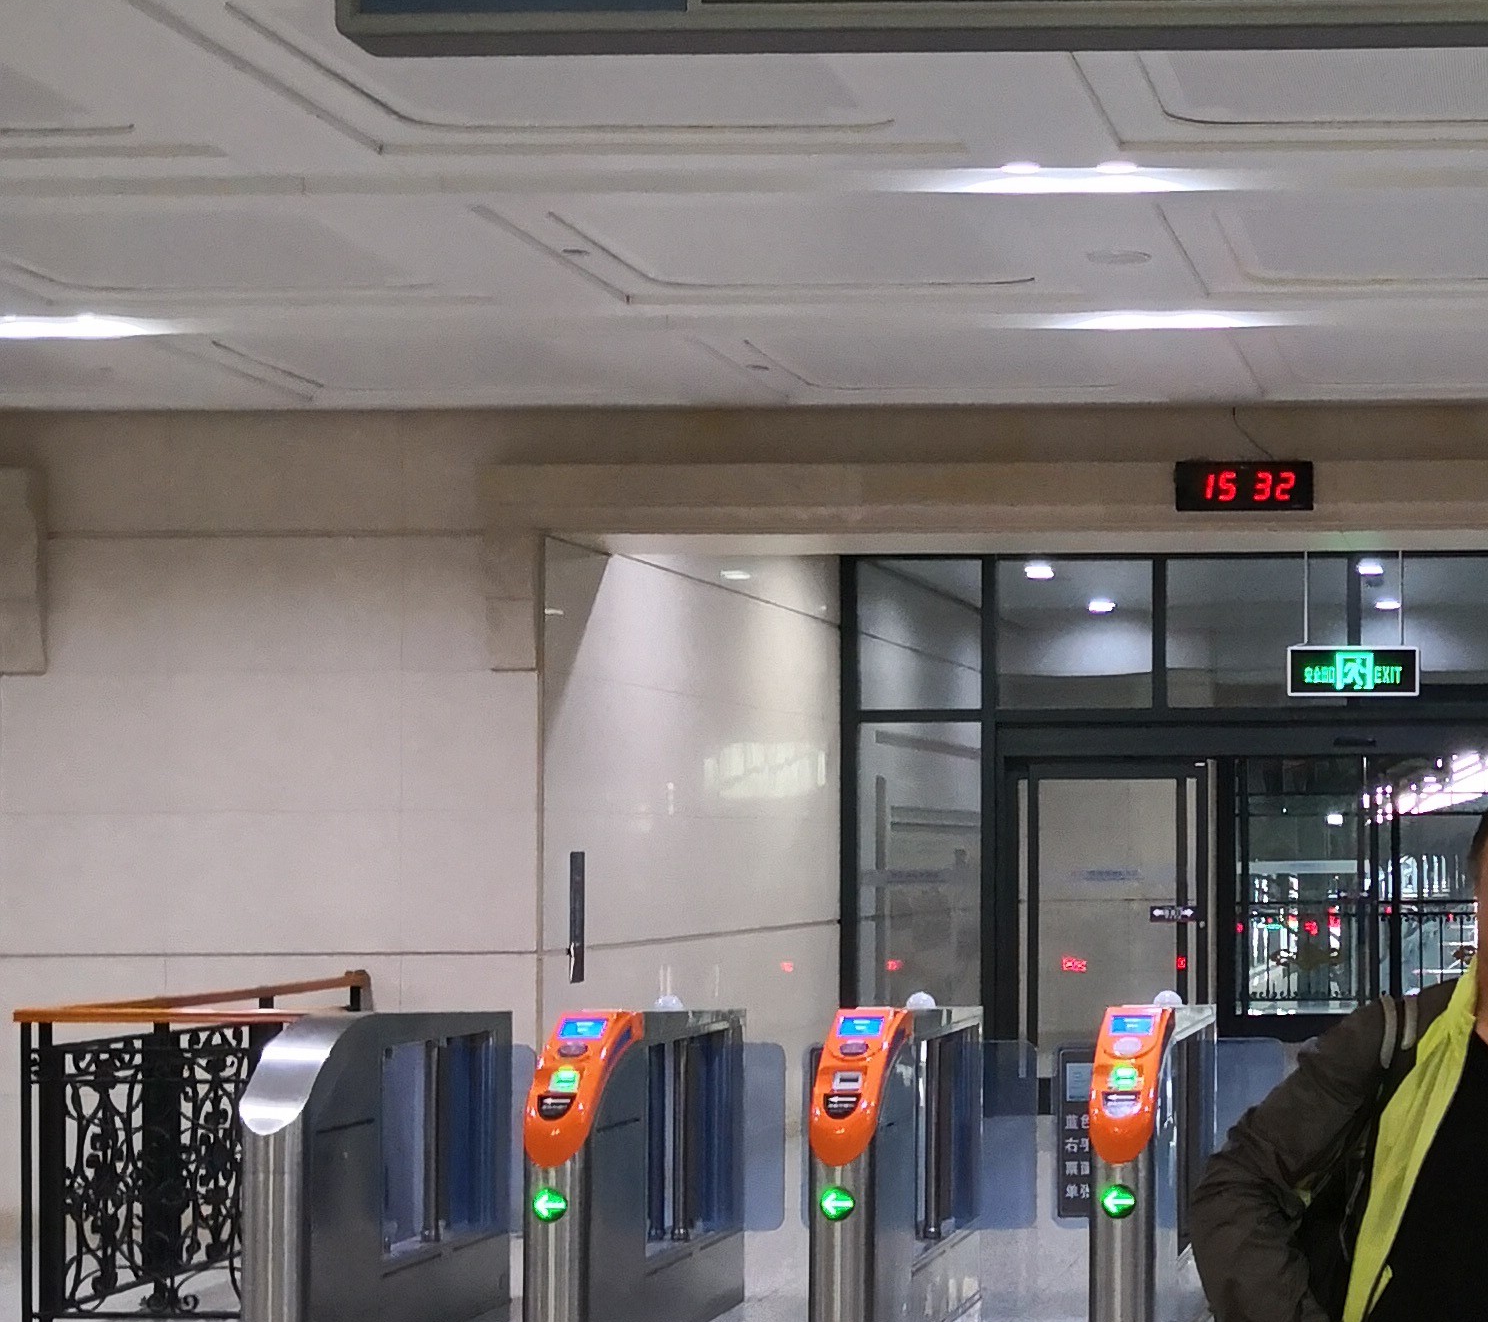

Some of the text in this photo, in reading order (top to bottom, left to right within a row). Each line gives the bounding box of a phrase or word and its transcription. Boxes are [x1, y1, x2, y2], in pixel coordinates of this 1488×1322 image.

[1205, 470, 1297, 502] 15 32
[1373, 666, 1403, 684] EXIT
